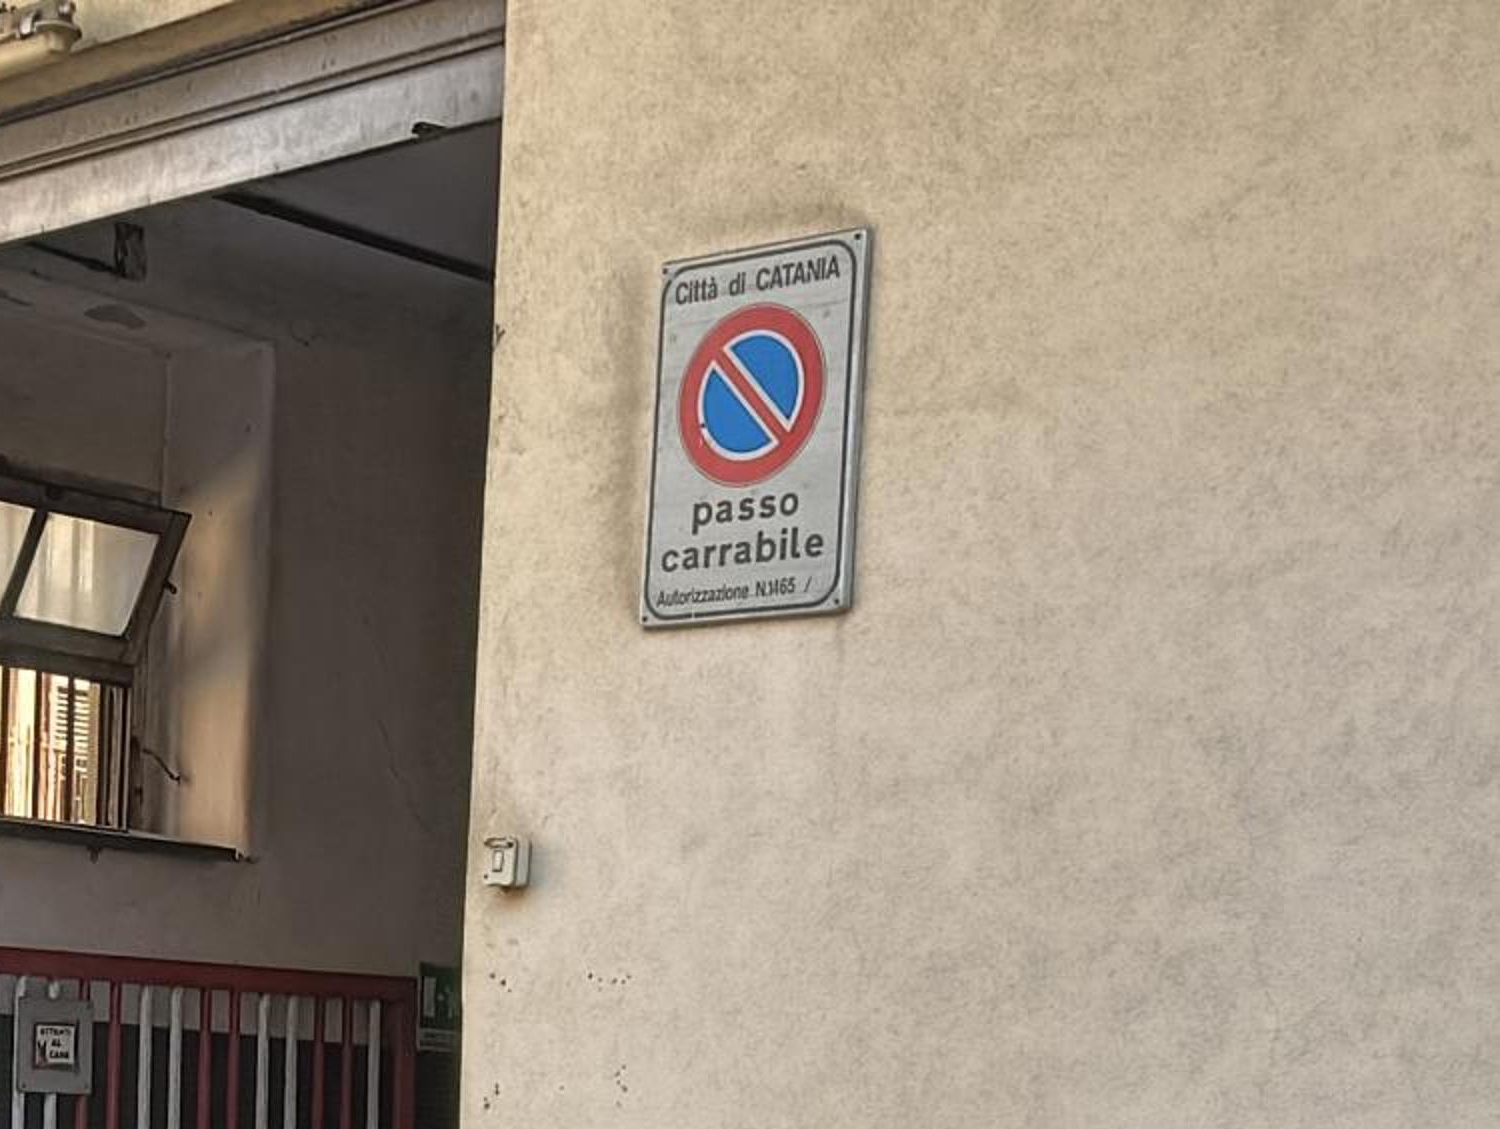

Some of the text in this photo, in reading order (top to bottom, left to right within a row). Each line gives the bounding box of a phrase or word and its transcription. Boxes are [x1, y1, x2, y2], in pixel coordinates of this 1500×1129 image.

[675, 254, 841, 305] Città di CATANIA
[691, 492, 800, 536] passo
[661, 526, 824, 573] carrabile
[656, 584, 749, 608] Autorizzazione
